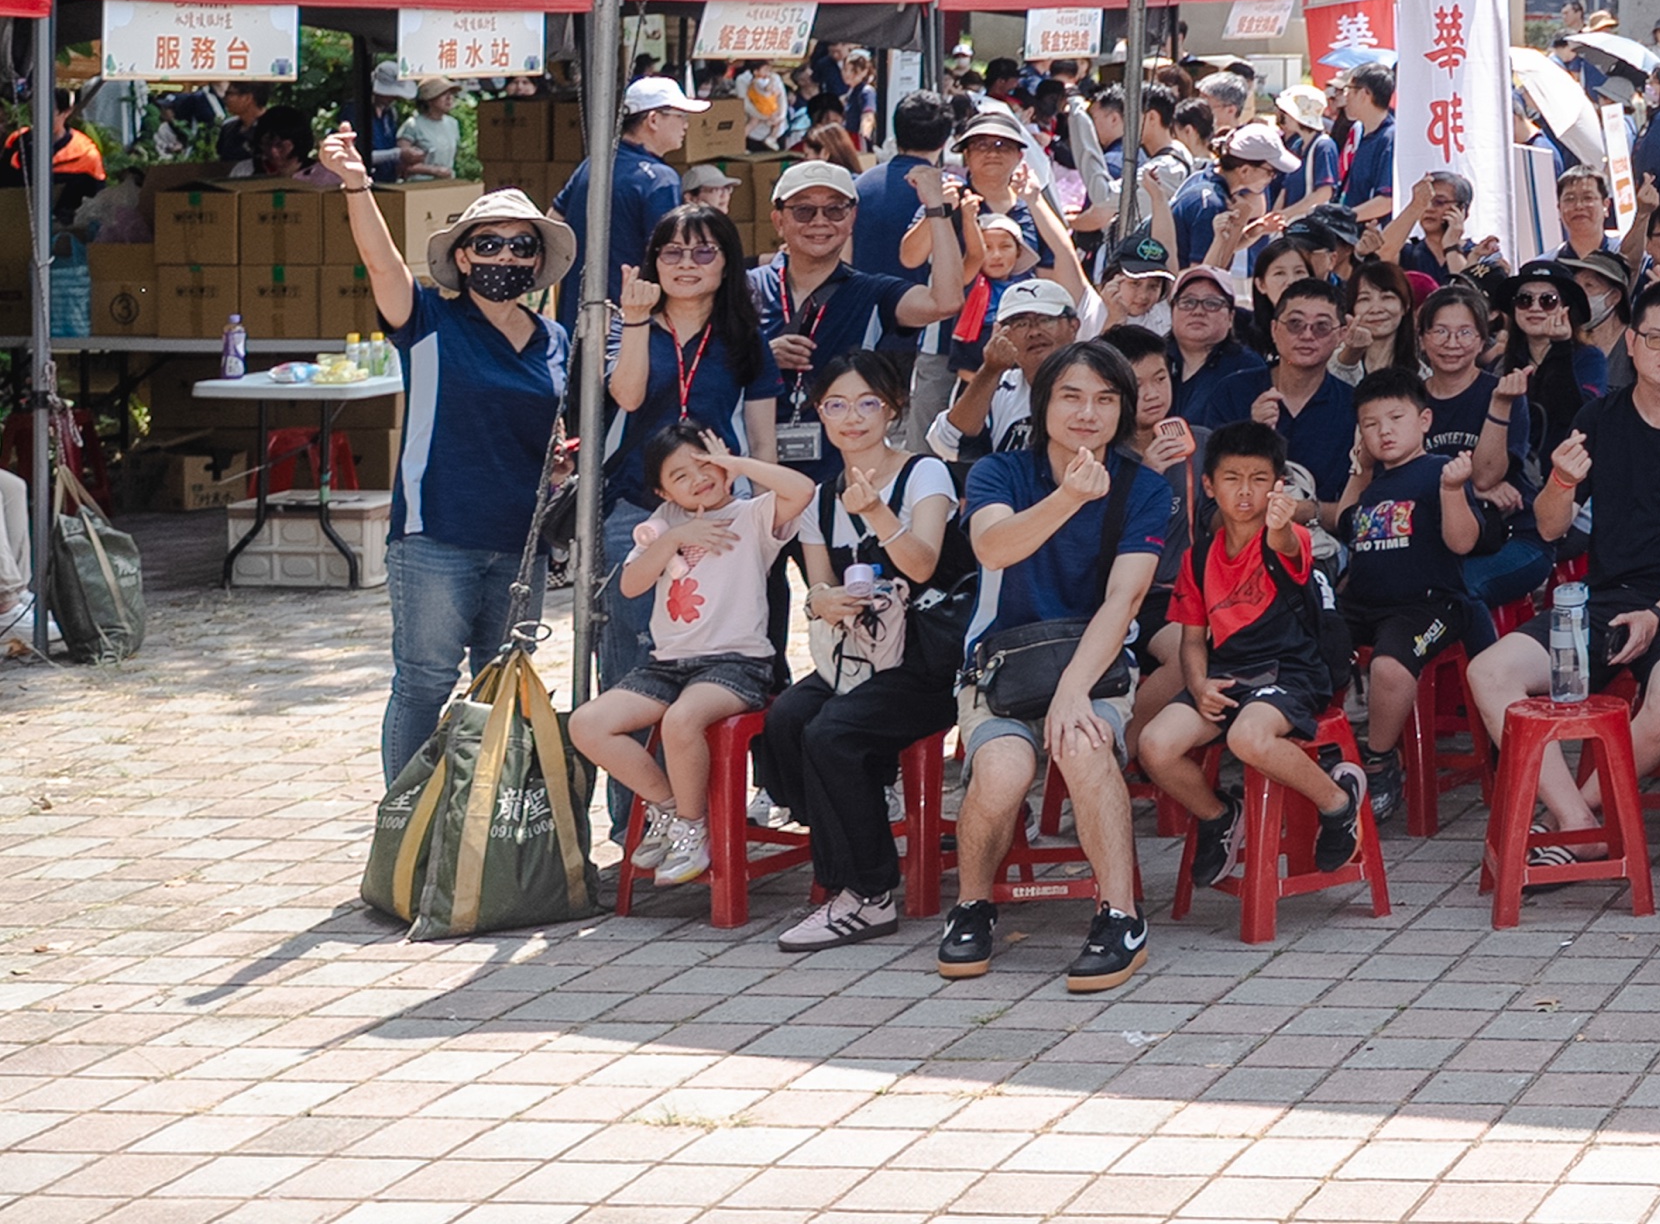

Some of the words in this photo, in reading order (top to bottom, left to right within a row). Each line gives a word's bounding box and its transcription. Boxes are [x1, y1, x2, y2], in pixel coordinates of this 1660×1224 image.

[155, 36, 250, 71] 服務台
[438, 37, 511, 69] 補水站
[1433, 431, 1463, 446] SWEET
[1373, 537, 1410, 551] TIME
[495, 787, 551, 821] 龍聖
